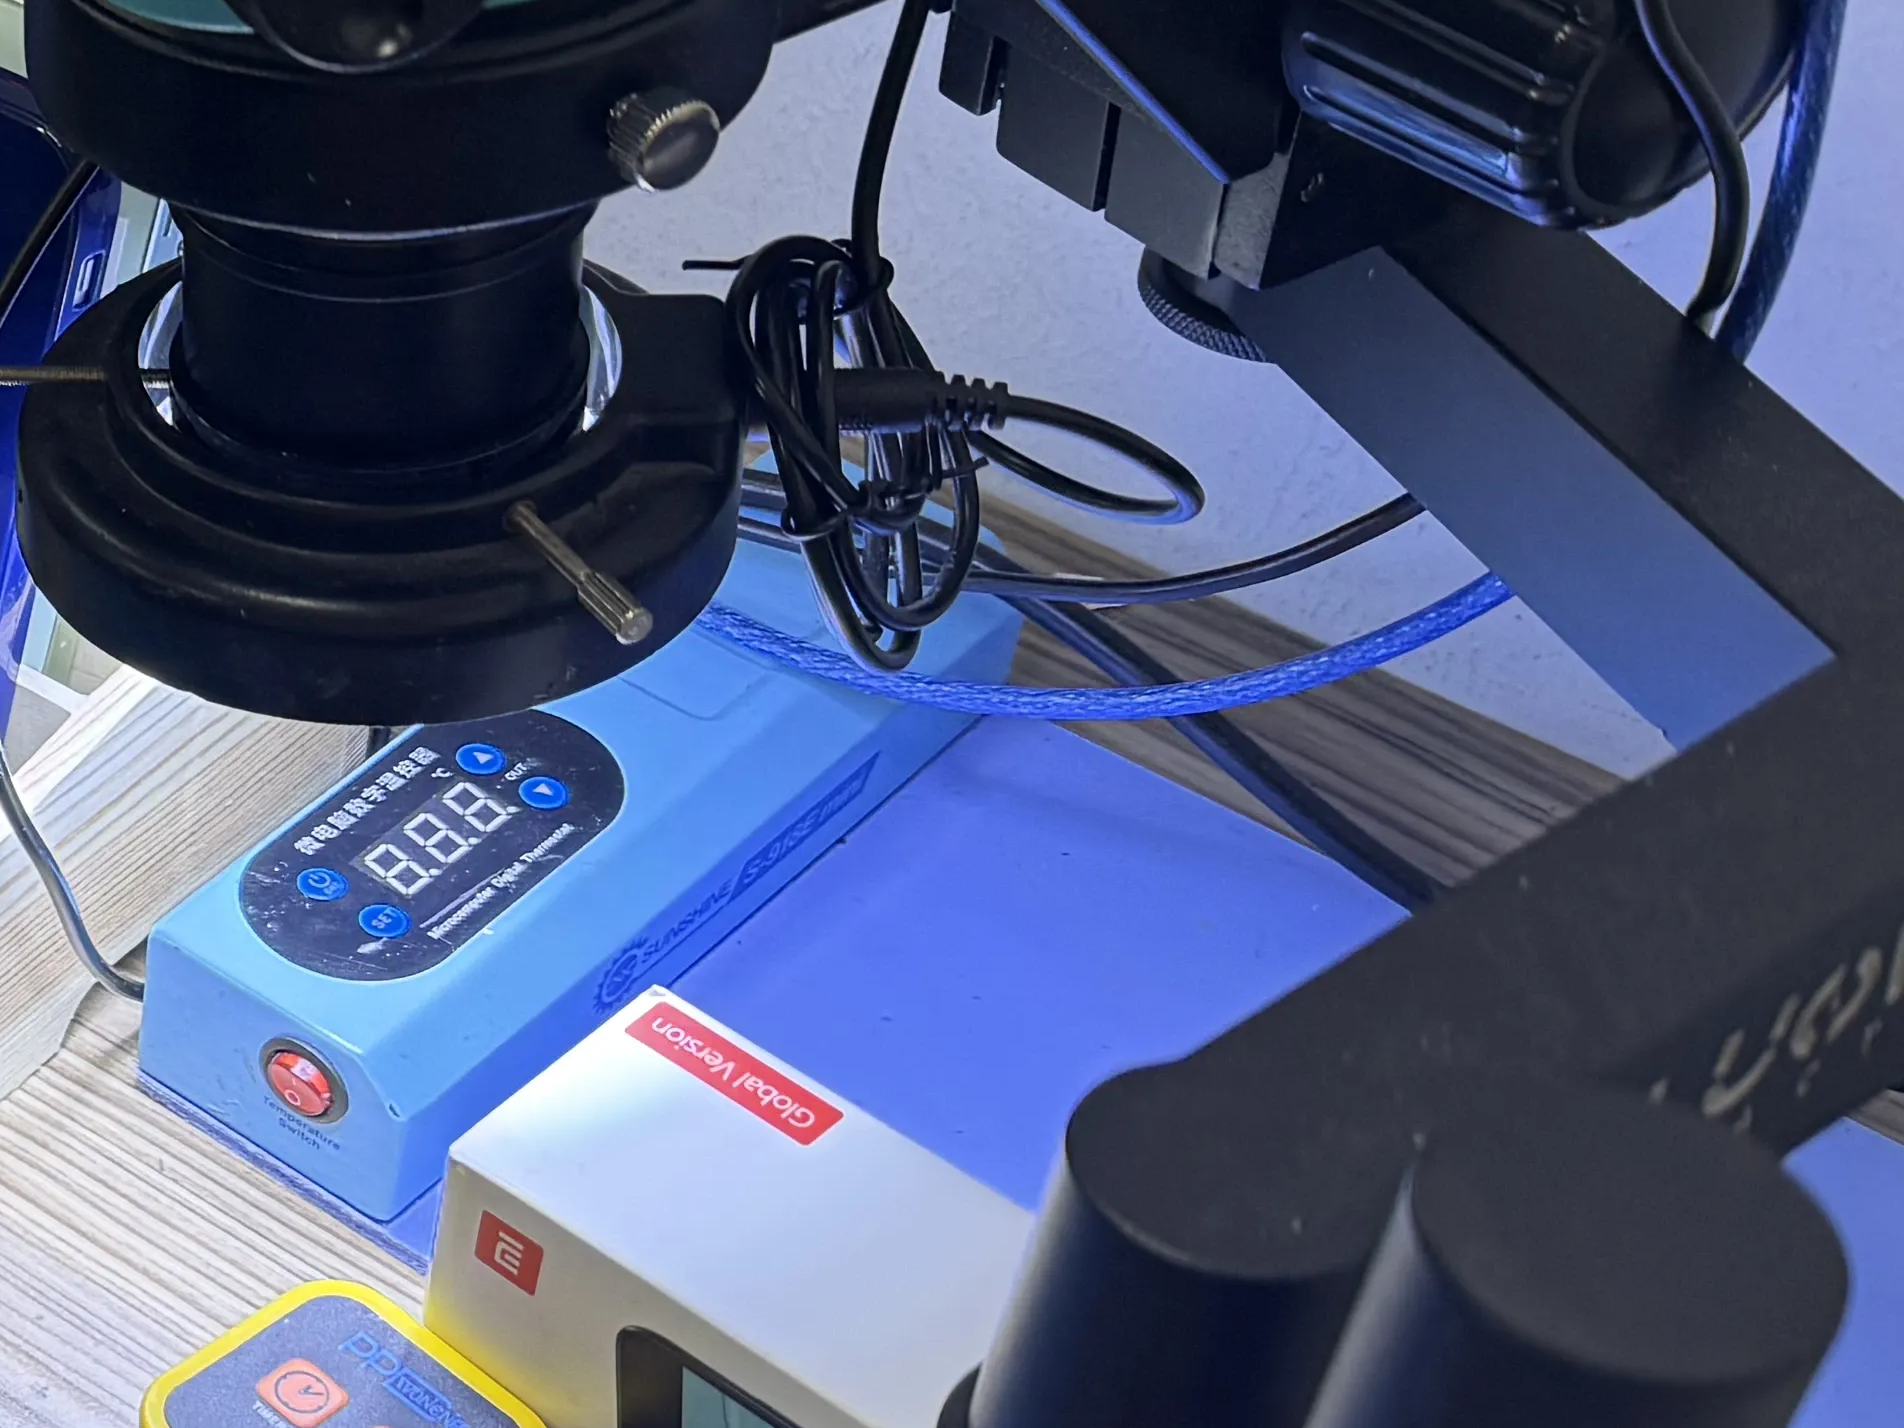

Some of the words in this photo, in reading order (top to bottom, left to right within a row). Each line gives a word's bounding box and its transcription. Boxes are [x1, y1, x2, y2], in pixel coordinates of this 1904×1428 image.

[371, 907, 401, 930] SET
[427, 886, 494, 940] Microcomputer
[641, 878, 733, 965] SUNSHINE
[647, 1014, 735, 1083] Version
[263, 1095, 341, 1151] Temperature
[734, 1069, 817, 1134] Global
[278, 1117, 321, 1150] Switch
